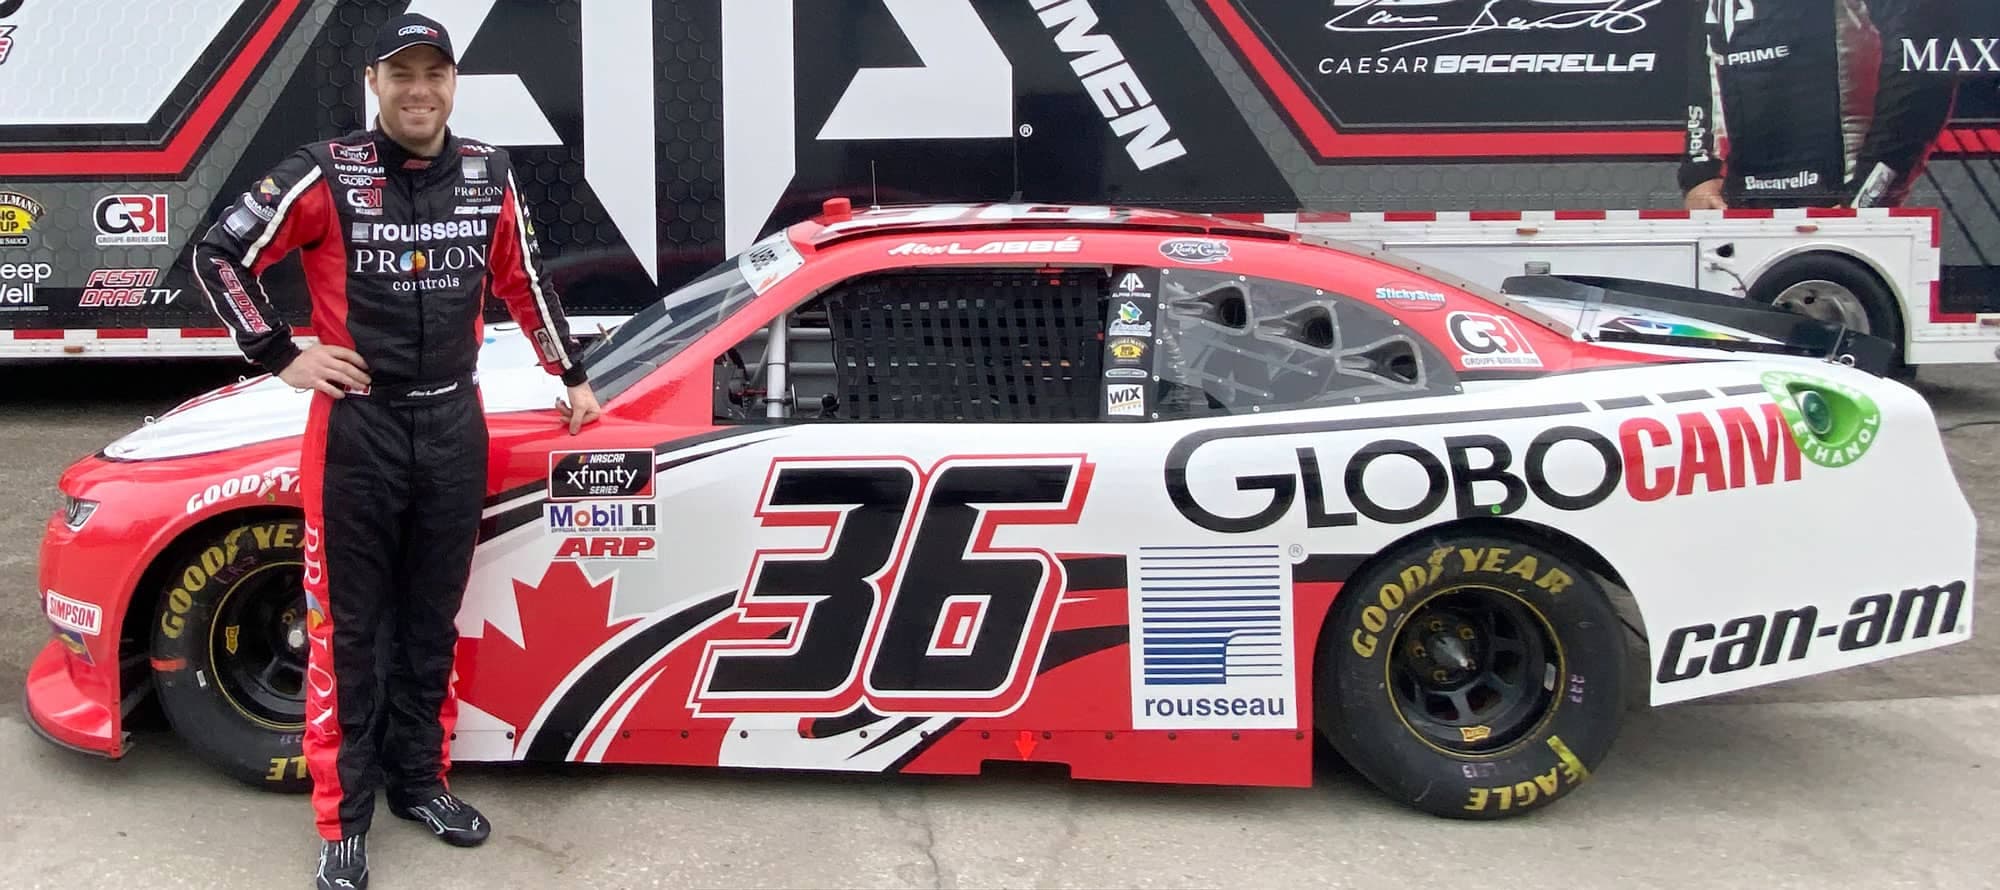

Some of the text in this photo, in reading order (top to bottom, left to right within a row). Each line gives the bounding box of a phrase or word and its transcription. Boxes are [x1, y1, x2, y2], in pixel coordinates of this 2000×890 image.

[1319, 53, 1656, 75] CAESAR BACARELLA
[1728, 45, 1790, 66] PRIME
[334, 163, 385, 174] GOODYEAR
[1745, 170, 1819, 190] Bacarella
[95, 195, 167, 235] GBI
[373, 219, 487, 242] rousseau
[946, 236, 1083, 255] LABBÉ
[354, 244, 487, 274] PROLON
[0, 263, 52, 284] eep
[86, 269, 159, 288] FESTI
[393, 275, 460, 291] controls
[0, 283, 34, 303] ell
[1110, 386, 1141, 405] WIX
[1792, 413, 1878, 463] ETHANOL
[590, 453, 626, 463] NASCAR
[567, 465, 638, 490] xfinity
[186, 468, 300, 514] GOODY
[589, 485, 619, 495] SERIES
[550, 504, 652, 527] Mobil 1
[554, 537, 655, 557] ARP
[162, 524, 307, 638] GOODYE
[695, 458, 1084, 706] 36
[49, 597, 96, 629] SIMPSON
[1352, 546, 1574, 658] GOODYEAR
[1656, 580, 1967, 684] can-am
[1145, 694, 1285, 717] rousseau
